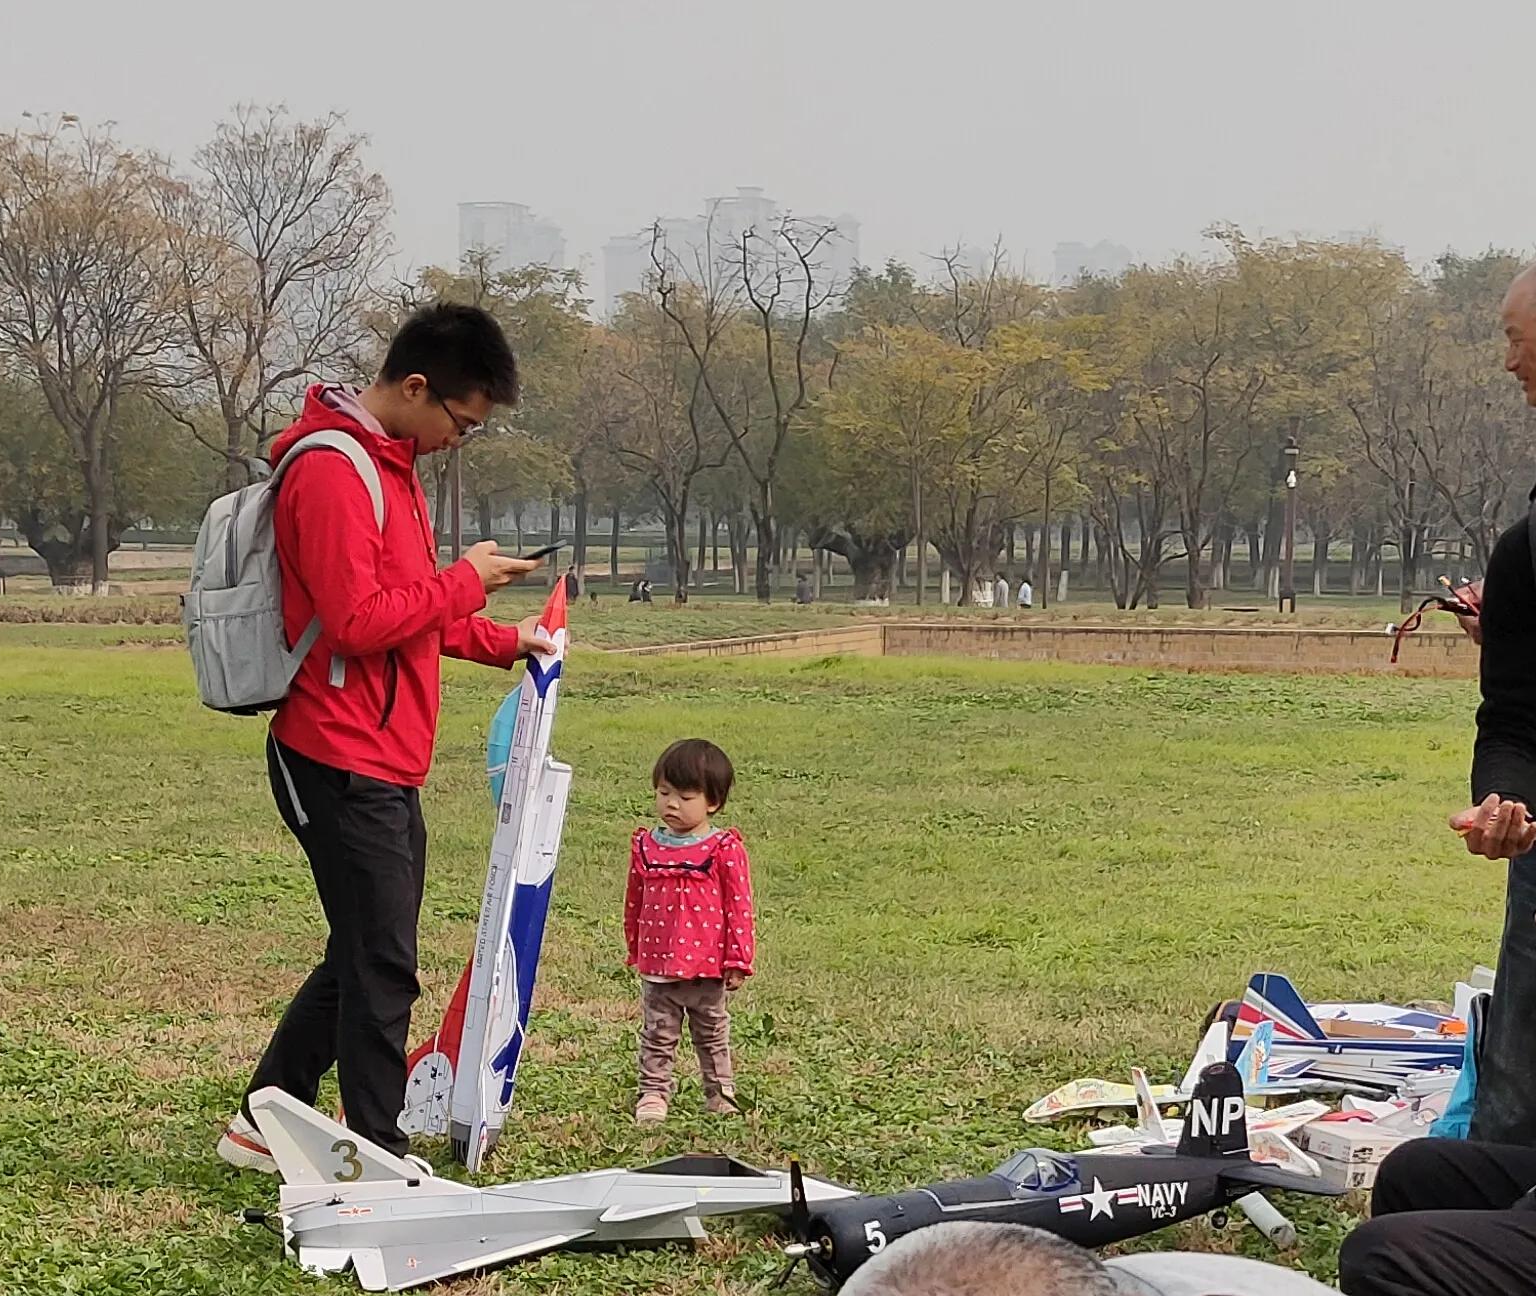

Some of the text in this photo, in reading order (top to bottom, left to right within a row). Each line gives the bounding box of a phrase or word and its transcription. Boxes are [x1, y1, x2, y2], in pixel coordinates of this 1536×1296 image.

[1190, 1096, 1245, 1138] NP
[330, 1139, 363, 1182] 3
[1137, 1182, 1189, 1207] NAVY
[864, 1220, 887, 1255] 5
